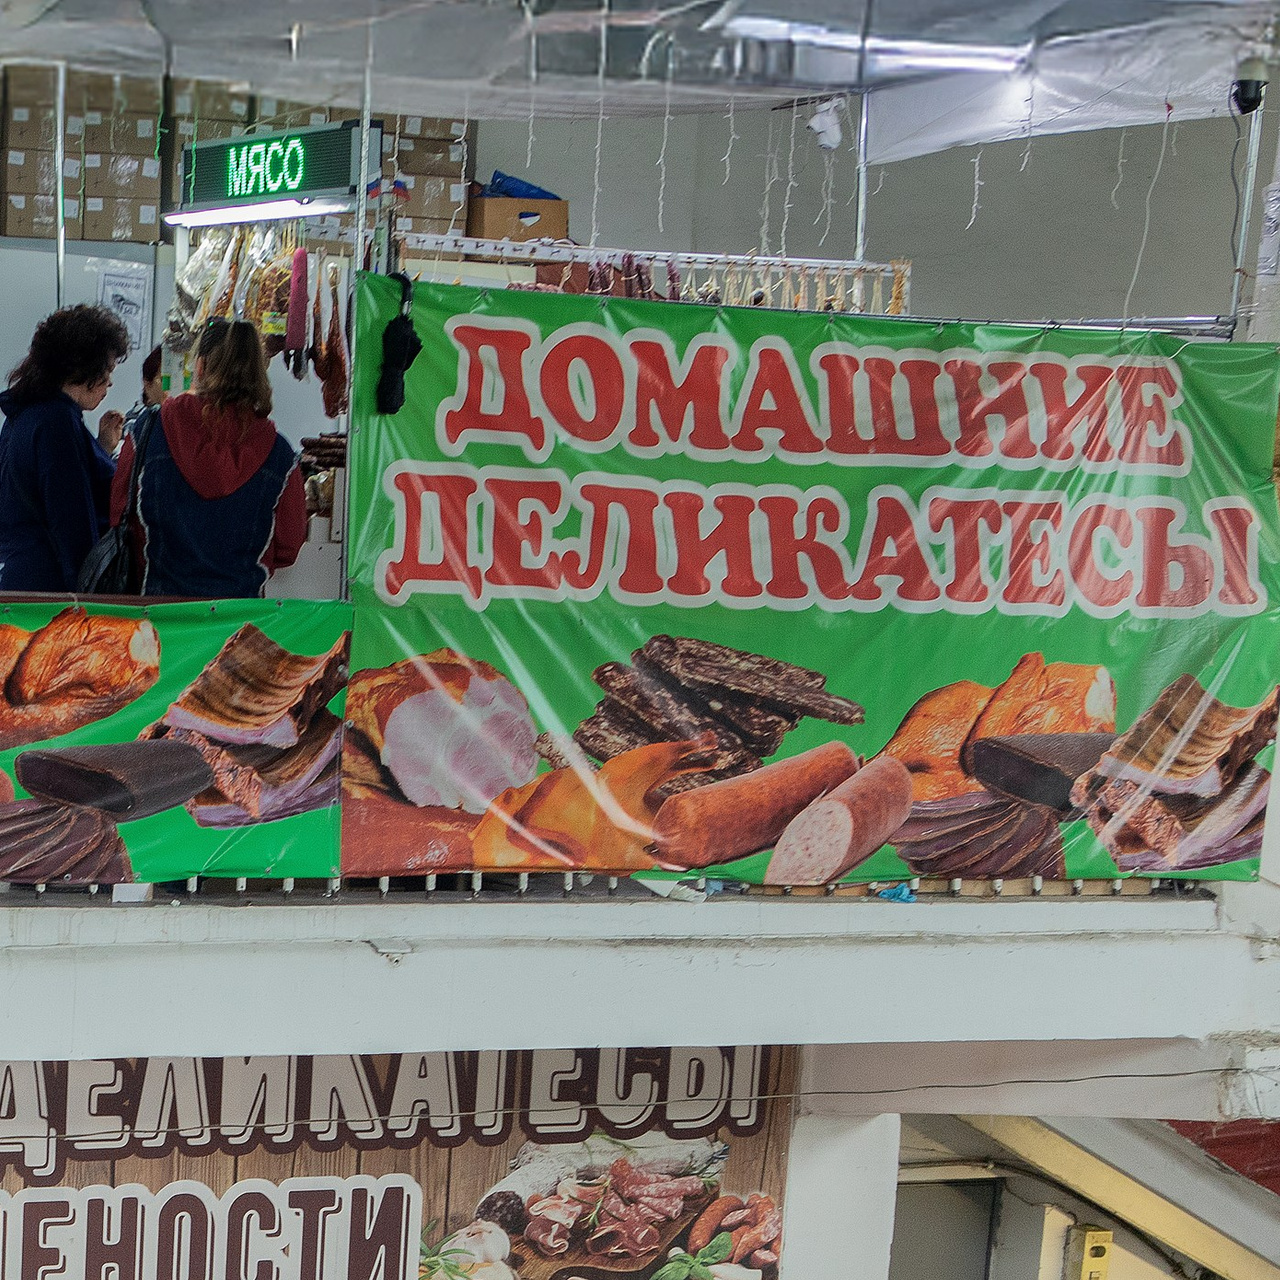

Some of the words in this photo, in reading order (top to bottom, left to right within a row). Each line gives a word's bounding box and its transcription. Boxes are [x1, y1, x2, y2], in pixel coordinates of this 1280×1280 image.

[227, 138, 305, 197] МЯСО
[441, 322, 1189, 469] ДОМАШНИЕ
[385, 470, 1260, 610] ДЕЛИКАТЕСЫ
